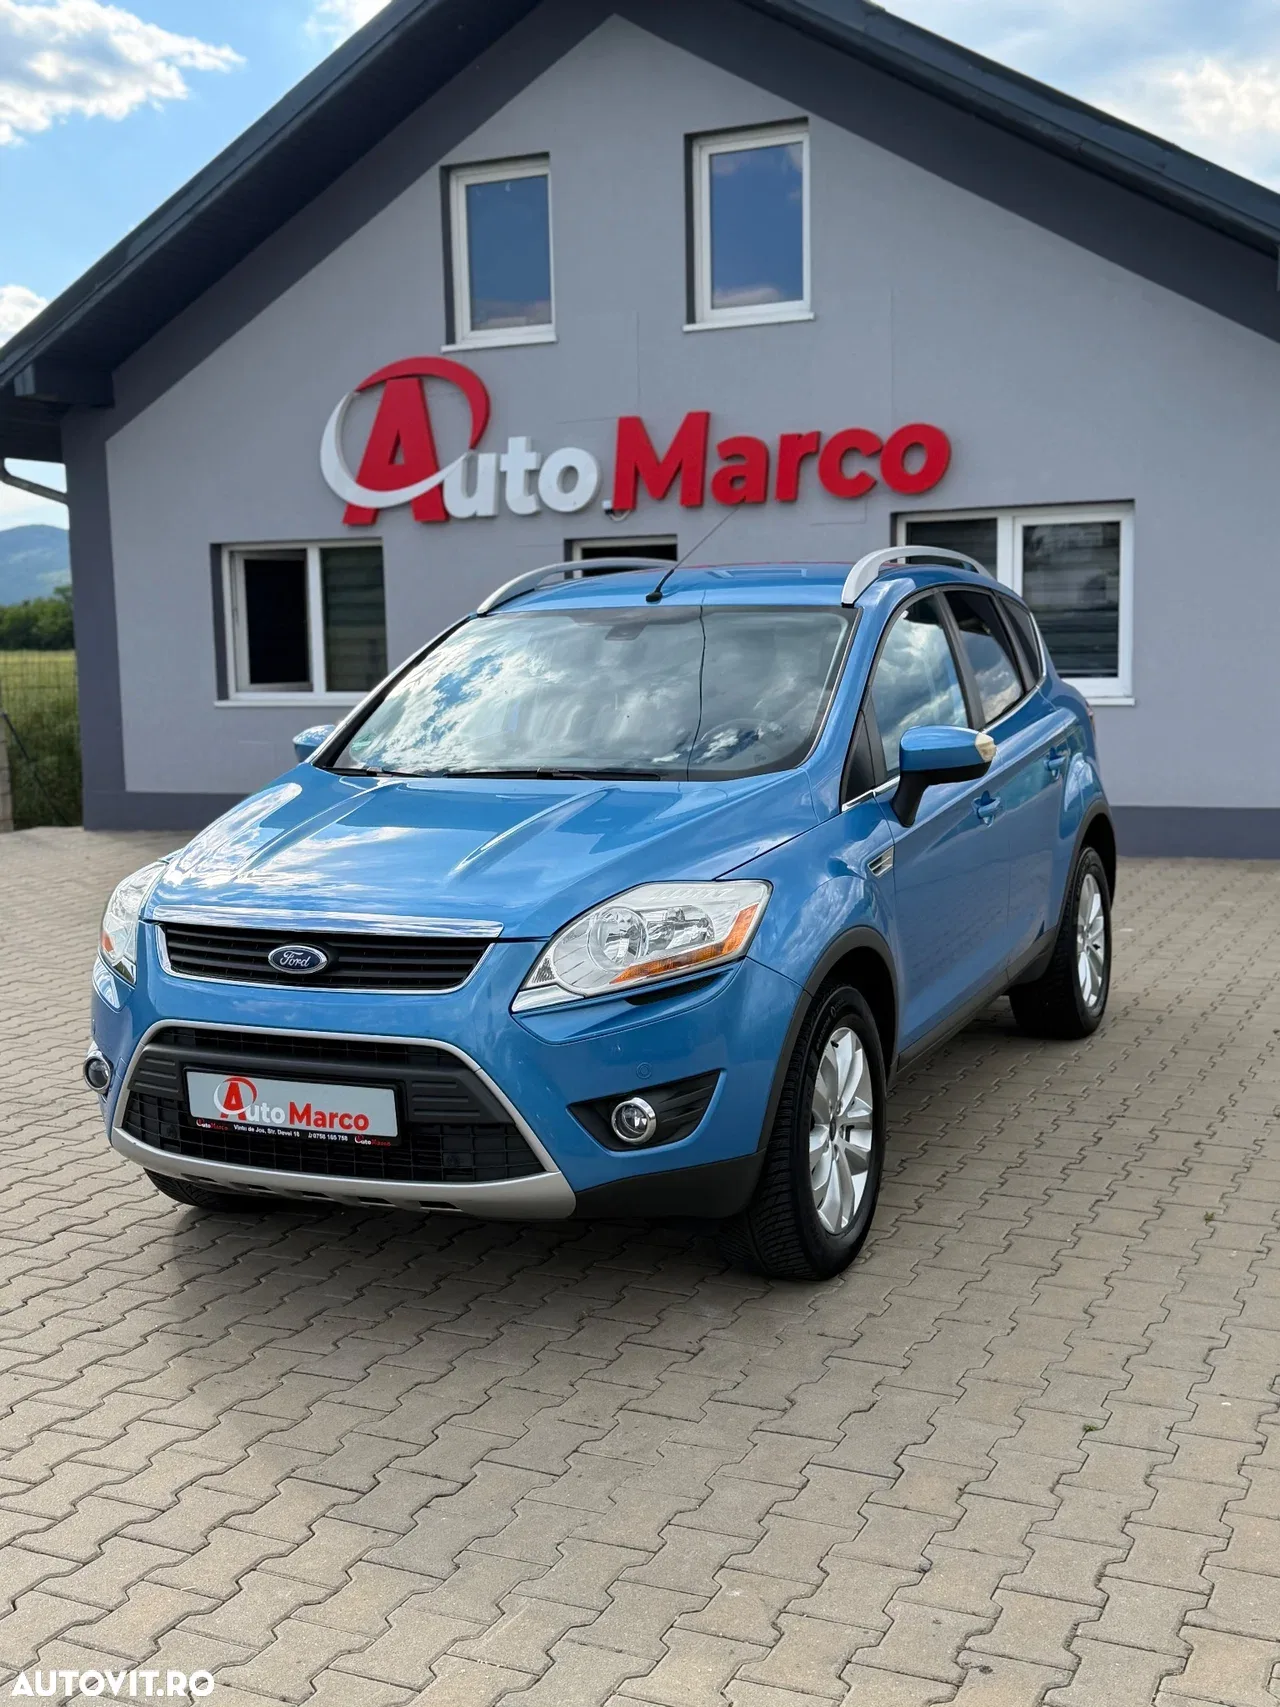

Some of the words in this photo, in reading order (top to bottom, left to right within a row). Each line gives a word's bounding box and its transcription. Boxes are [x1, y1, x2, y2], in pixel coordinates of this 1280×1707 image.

[336, 374, 601, 526] Auto
[613, 410, 952, 511] Marco
[279, 950, 311, 967] Ford
[218, 1078, 286, 1124] Auto
[288, 1101, 370, 1131] Marco
